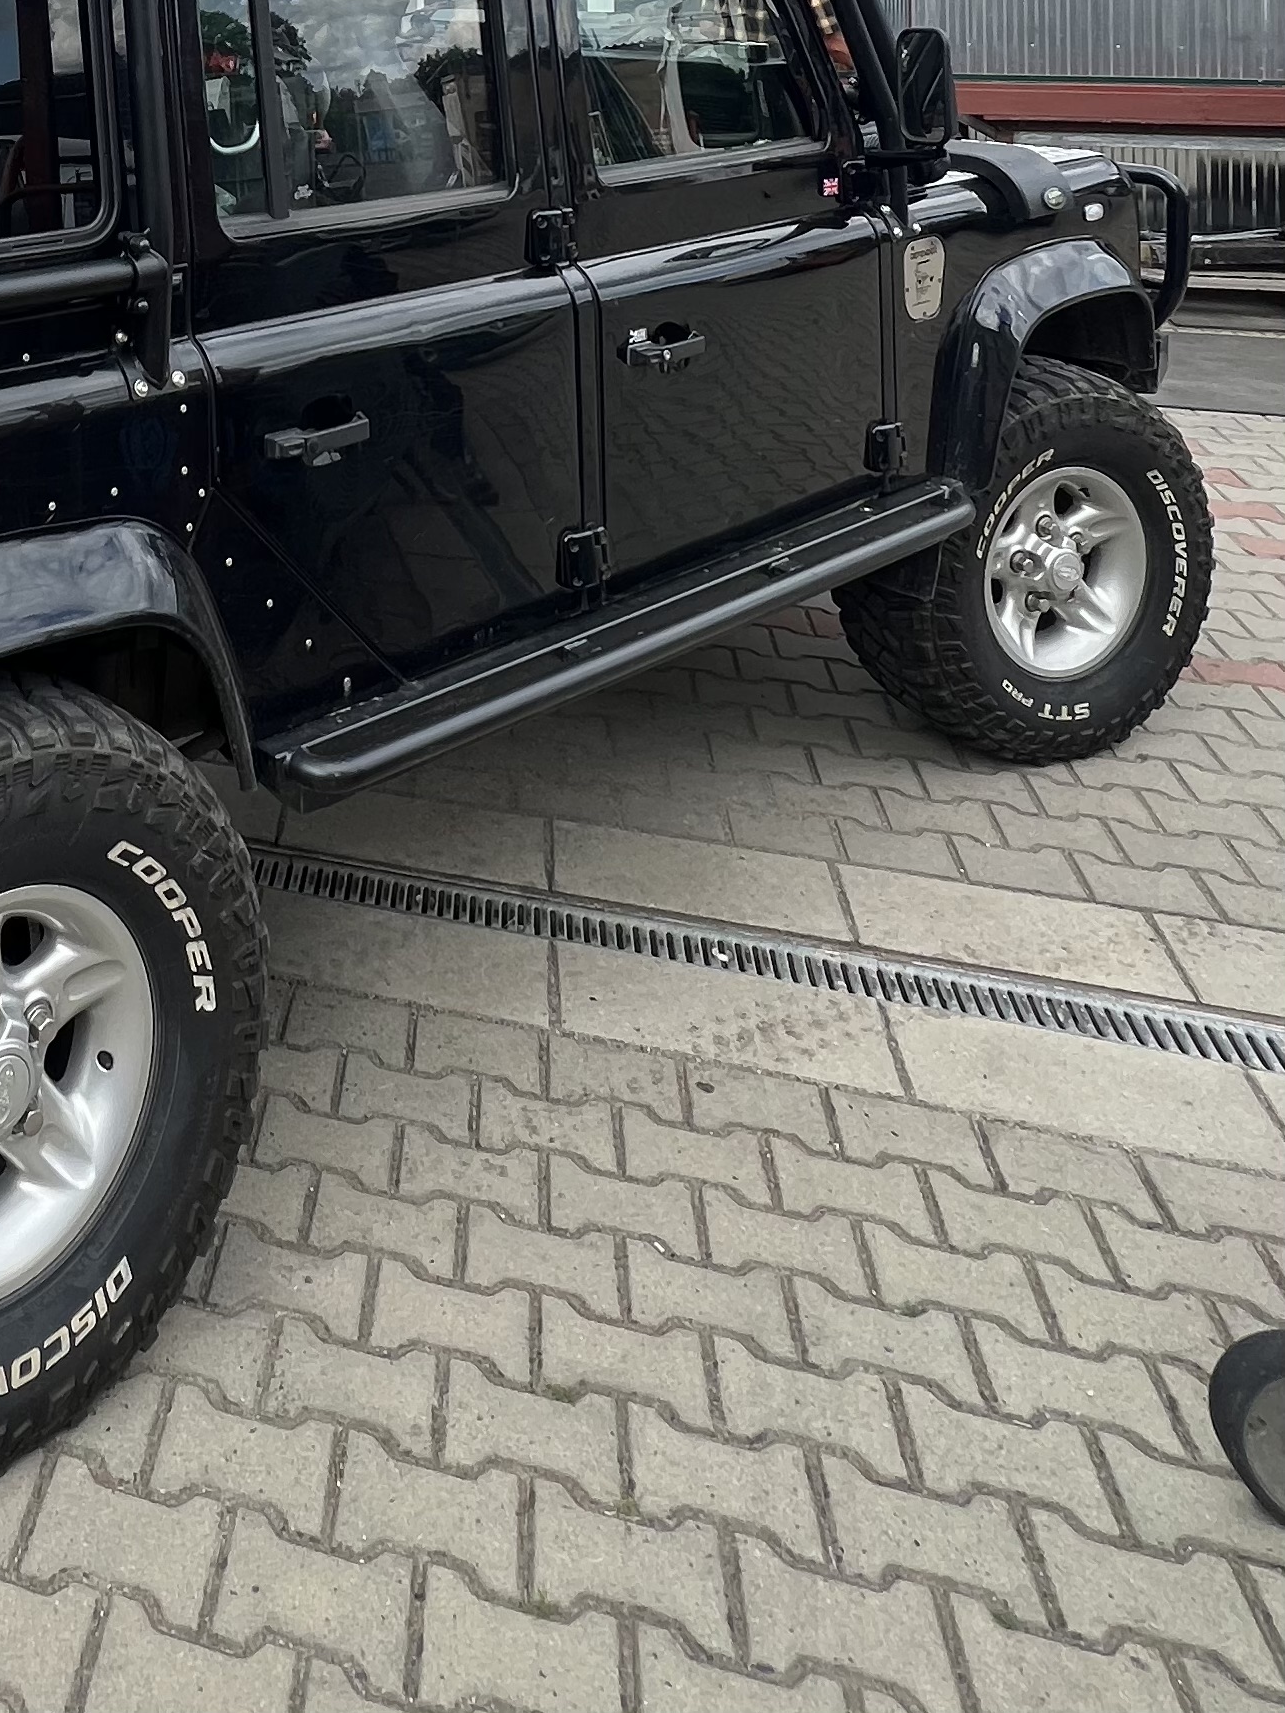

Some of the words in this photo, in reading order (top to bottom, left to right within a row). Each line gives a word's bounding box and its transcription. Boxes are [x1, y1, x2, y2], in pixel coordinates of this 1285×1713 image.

[976, 448, 1055, 560] COOPER
[1146, 468, 1189, 638] DISCOVERER
[1001, 678, 1035, 708] PRO
[1037, 701, 1092, 722] STT
[106, 839, 217, 1013] COOPER
